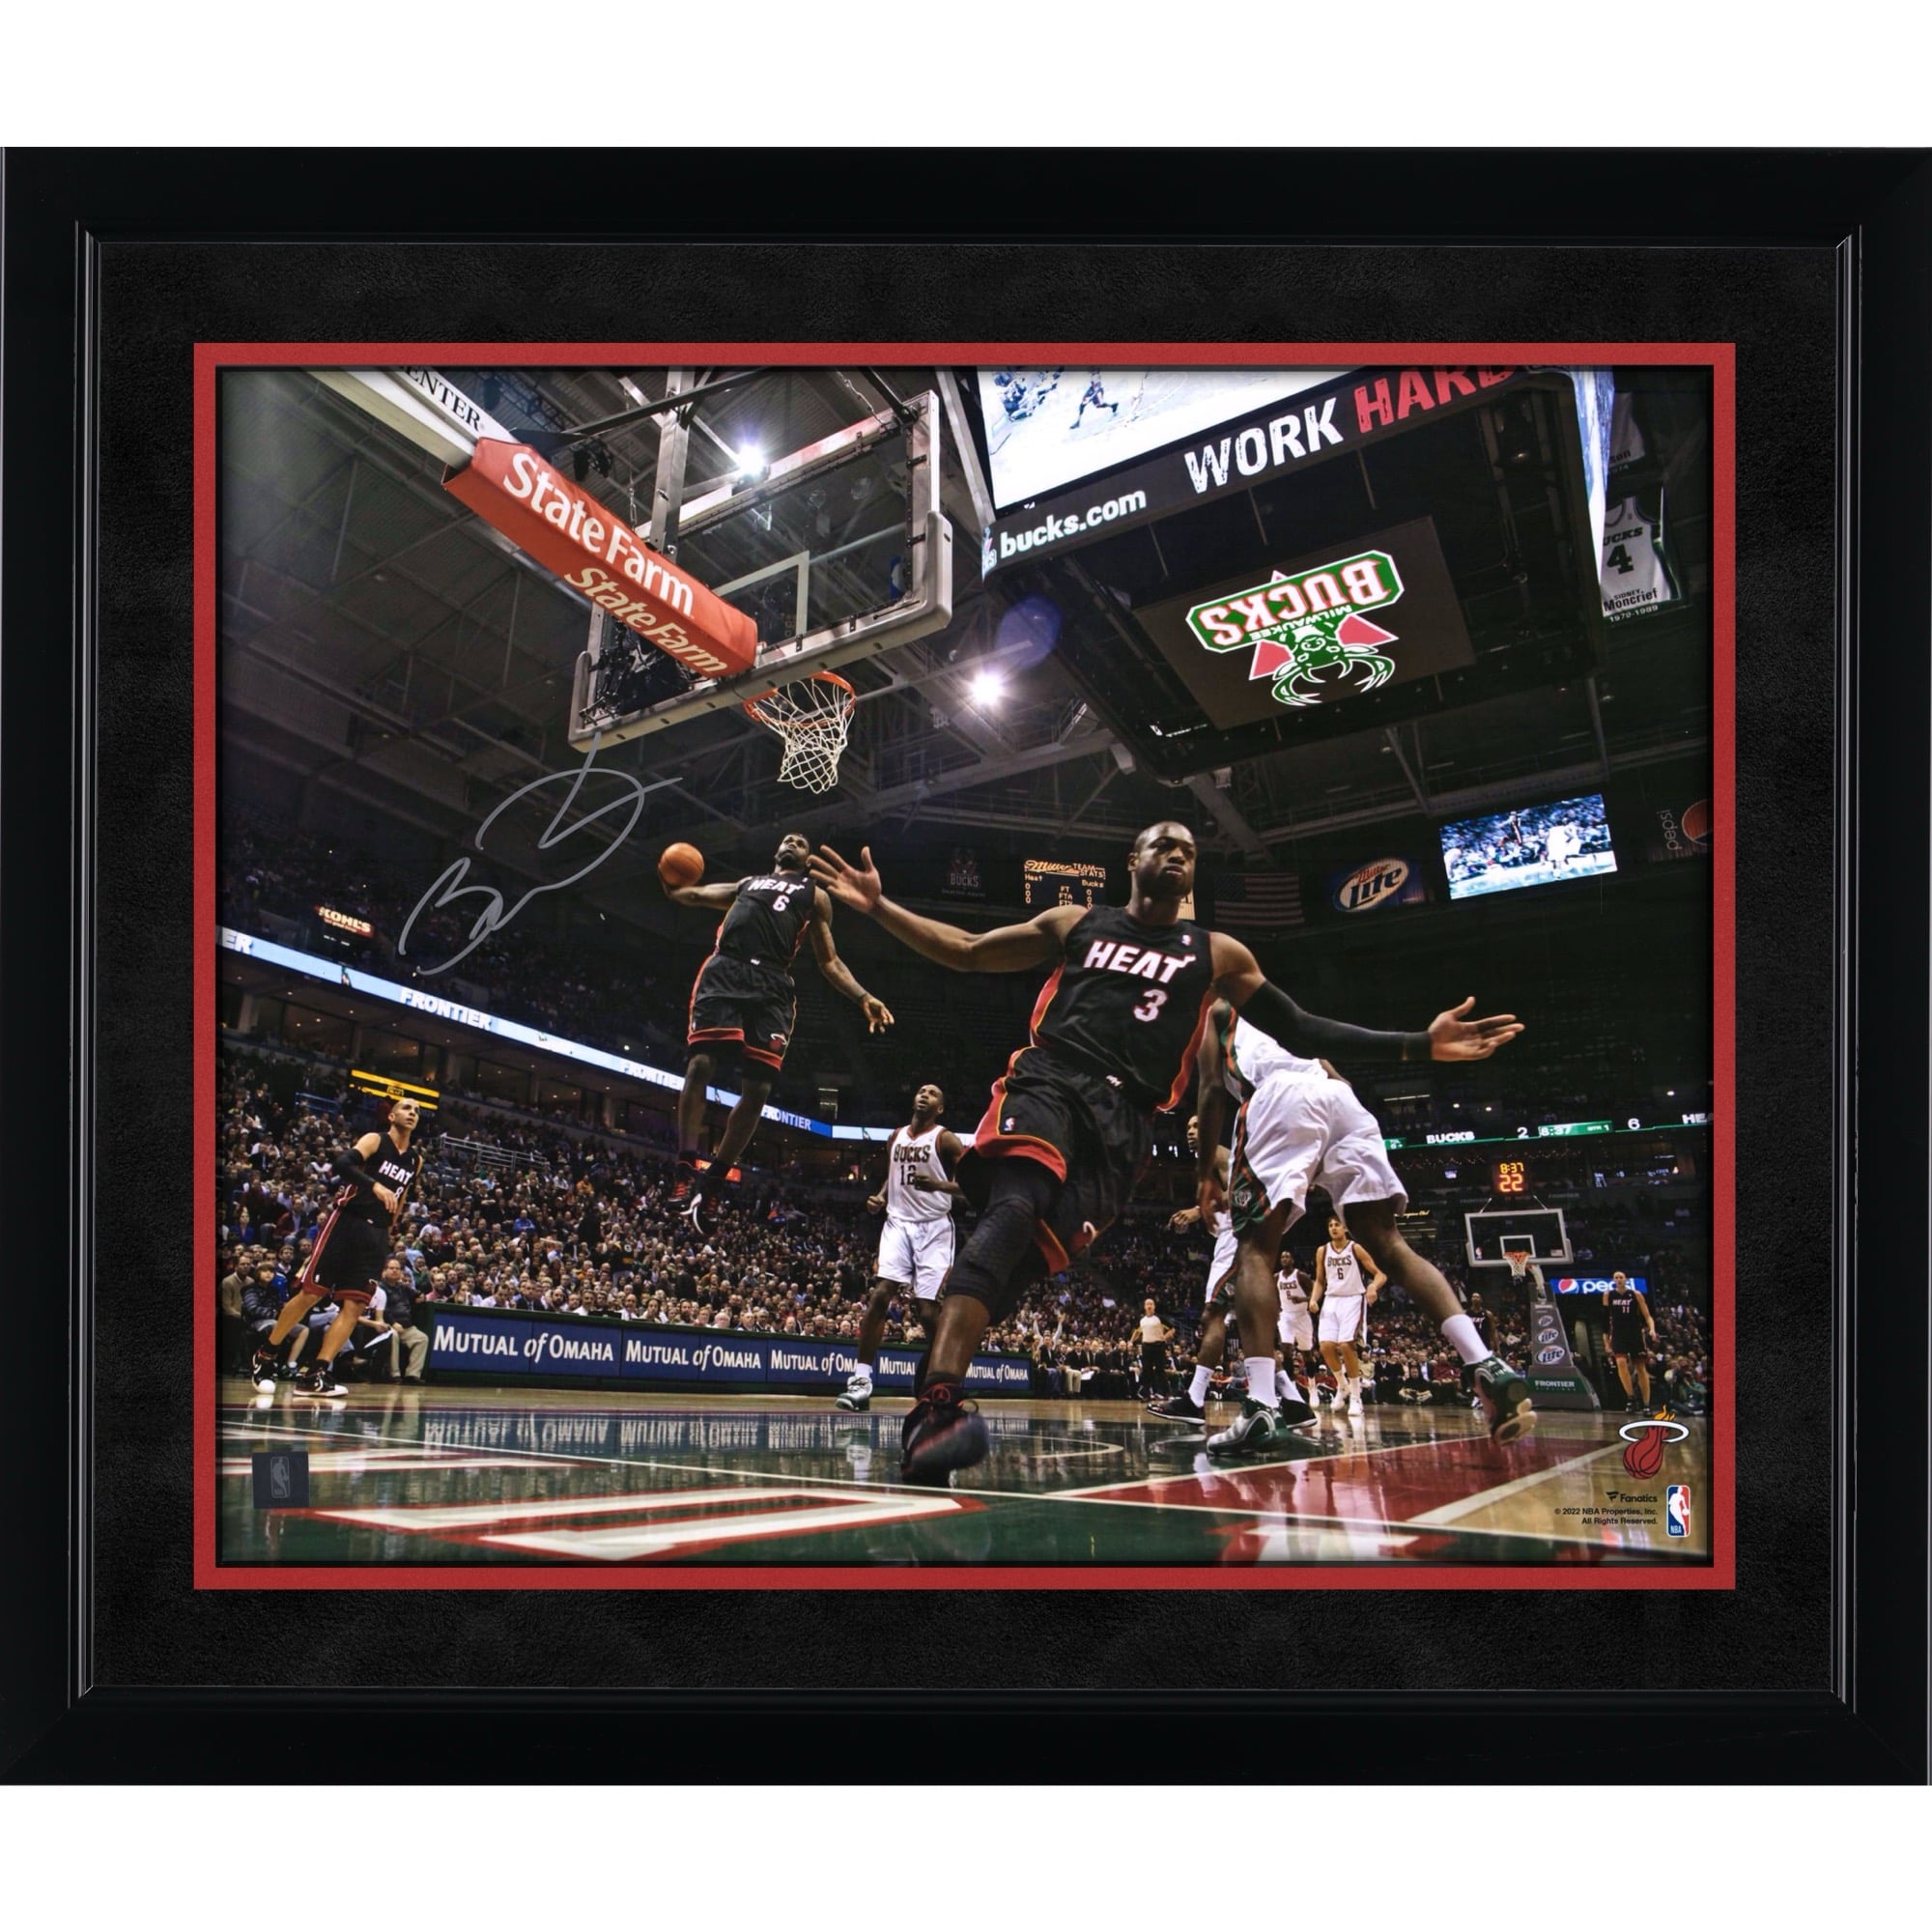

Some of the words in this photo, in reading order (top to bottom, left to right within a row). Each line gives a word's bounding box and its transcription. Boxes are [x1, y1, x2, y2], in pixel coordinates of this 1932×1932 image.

[1184, 397, 1344, 494] WORK
[503, 452, 605, 553] State
[606, 525, 695, 615] Farm
[1000, 490, 1147, 559] bucks.com
[1604, 526, 1643, 547] UCKS
[1606, 543, 1634, 575] 4
[1199, 557, 1392, 646] BUCKS
[1604, 587, 1659, 612] Moncrief
[564, 566, 657, 628] State
[642, 621, 727, 673] Farm
[1249, 604, 1352, 641] MILWAUKEE
[1656, 810, 1684, 850] pepsi
[748, 877, 806, 895] HEAT
[950, 872, 980, 888] BUCKS
[1082, 879, 1104, 888] Bucks
[1350, 867, 1402, 909] Lite
[773, 895, 790, 912] 6
[1082, 940, 1197, 983] HEAT
[400, 985, 493, 1033] FRONTIER
[1133, 988, 1168, 1022] 3
[761, 1104, 812, 1131] FRONTIER
[1426, 1131, 1475, 1144] BUCKS
[1517, 1126, 1529, 1138] 2
[1541, 1124, 1574, 1136] 8:37
[1628, 1118, 1640, 1130] 6
[894, 1143, 931, 1163] BUCKS
[378, 1160, 415, 1185] HEAT
[1499, 1162, 1524, 1174] 8:37
[1499, 1173, 1524, 1192] 22
[1327, 1255, 1352, 1267] BUCKS
[1337, 1266, 1345, 1280] 6
[433, 1325, 519, 1356] MUTUAL
[524, 1332, 549, 1364] of
[549, 1334, 614, 1362] OMAHA
[625, 1340, 690, 1366] MUTUAL
[693, 1345, 712, 1372] of
[712, 1346, 762, 1370] OMAHA
[771, 1350, 818, 1372] MUTUAL
[821, 1352, 836, 1377] of
[996, 1364, 1005, 1383] of
[1005, 1364, 1029, 1380] OMAHA
[1534, 1379, 1576, 1388] FRONTIER
